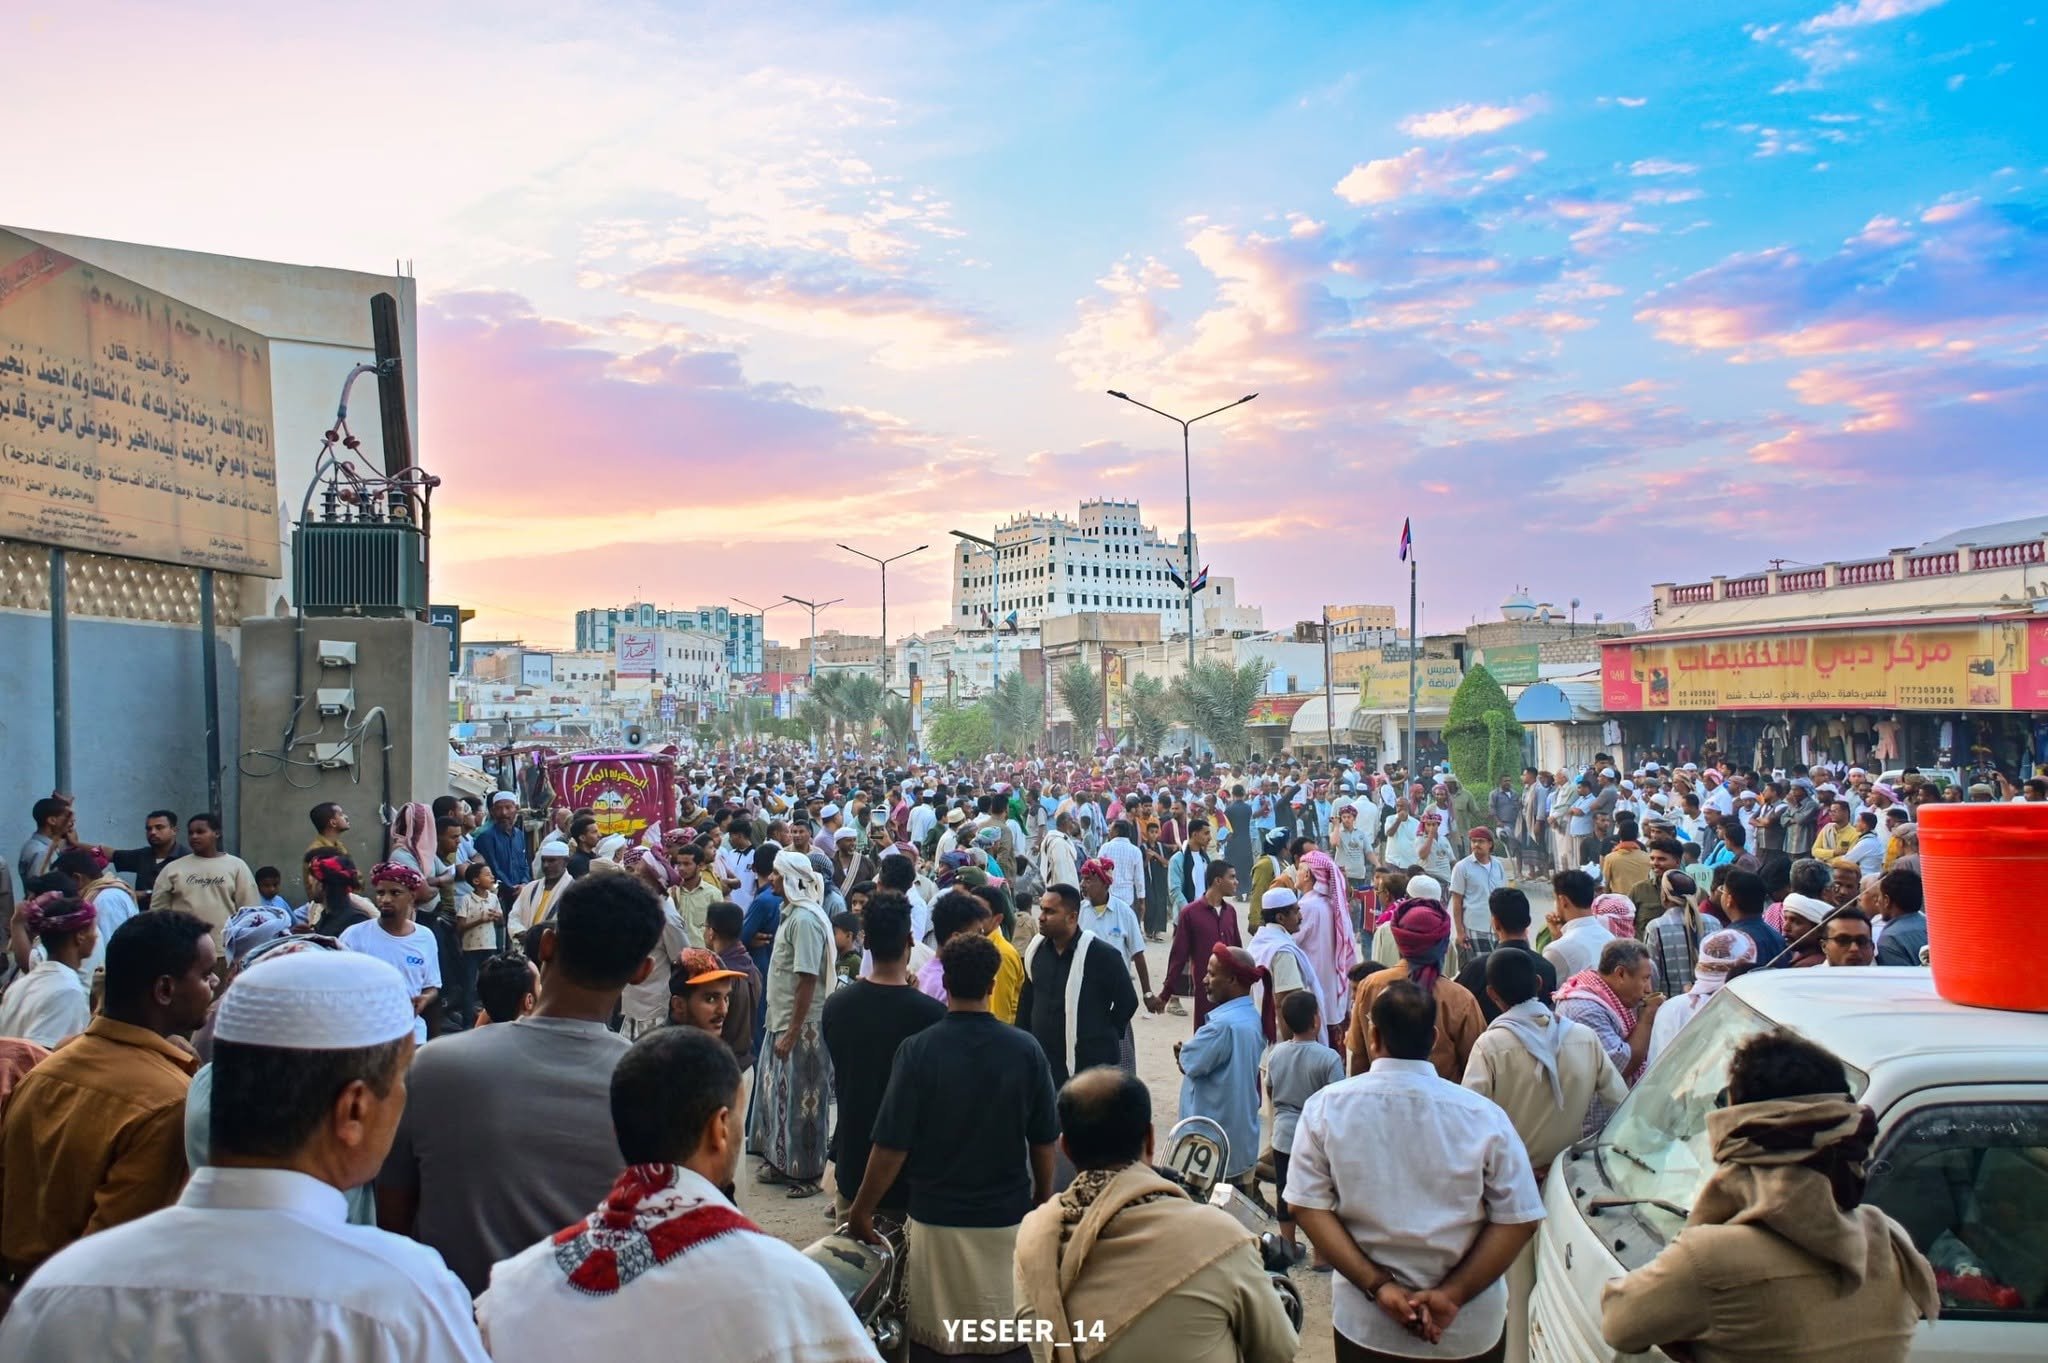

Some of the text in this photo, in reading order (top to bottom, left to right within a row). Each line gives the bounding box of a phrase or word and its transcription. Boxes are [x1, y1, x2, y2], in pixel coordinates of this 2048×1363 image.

[1677, 632, 1953, 680] مركز دبي للتخفيضات
[1861, 688, 1888, 701] ملابس
[1181, 1140, 1213, 1177] 19
